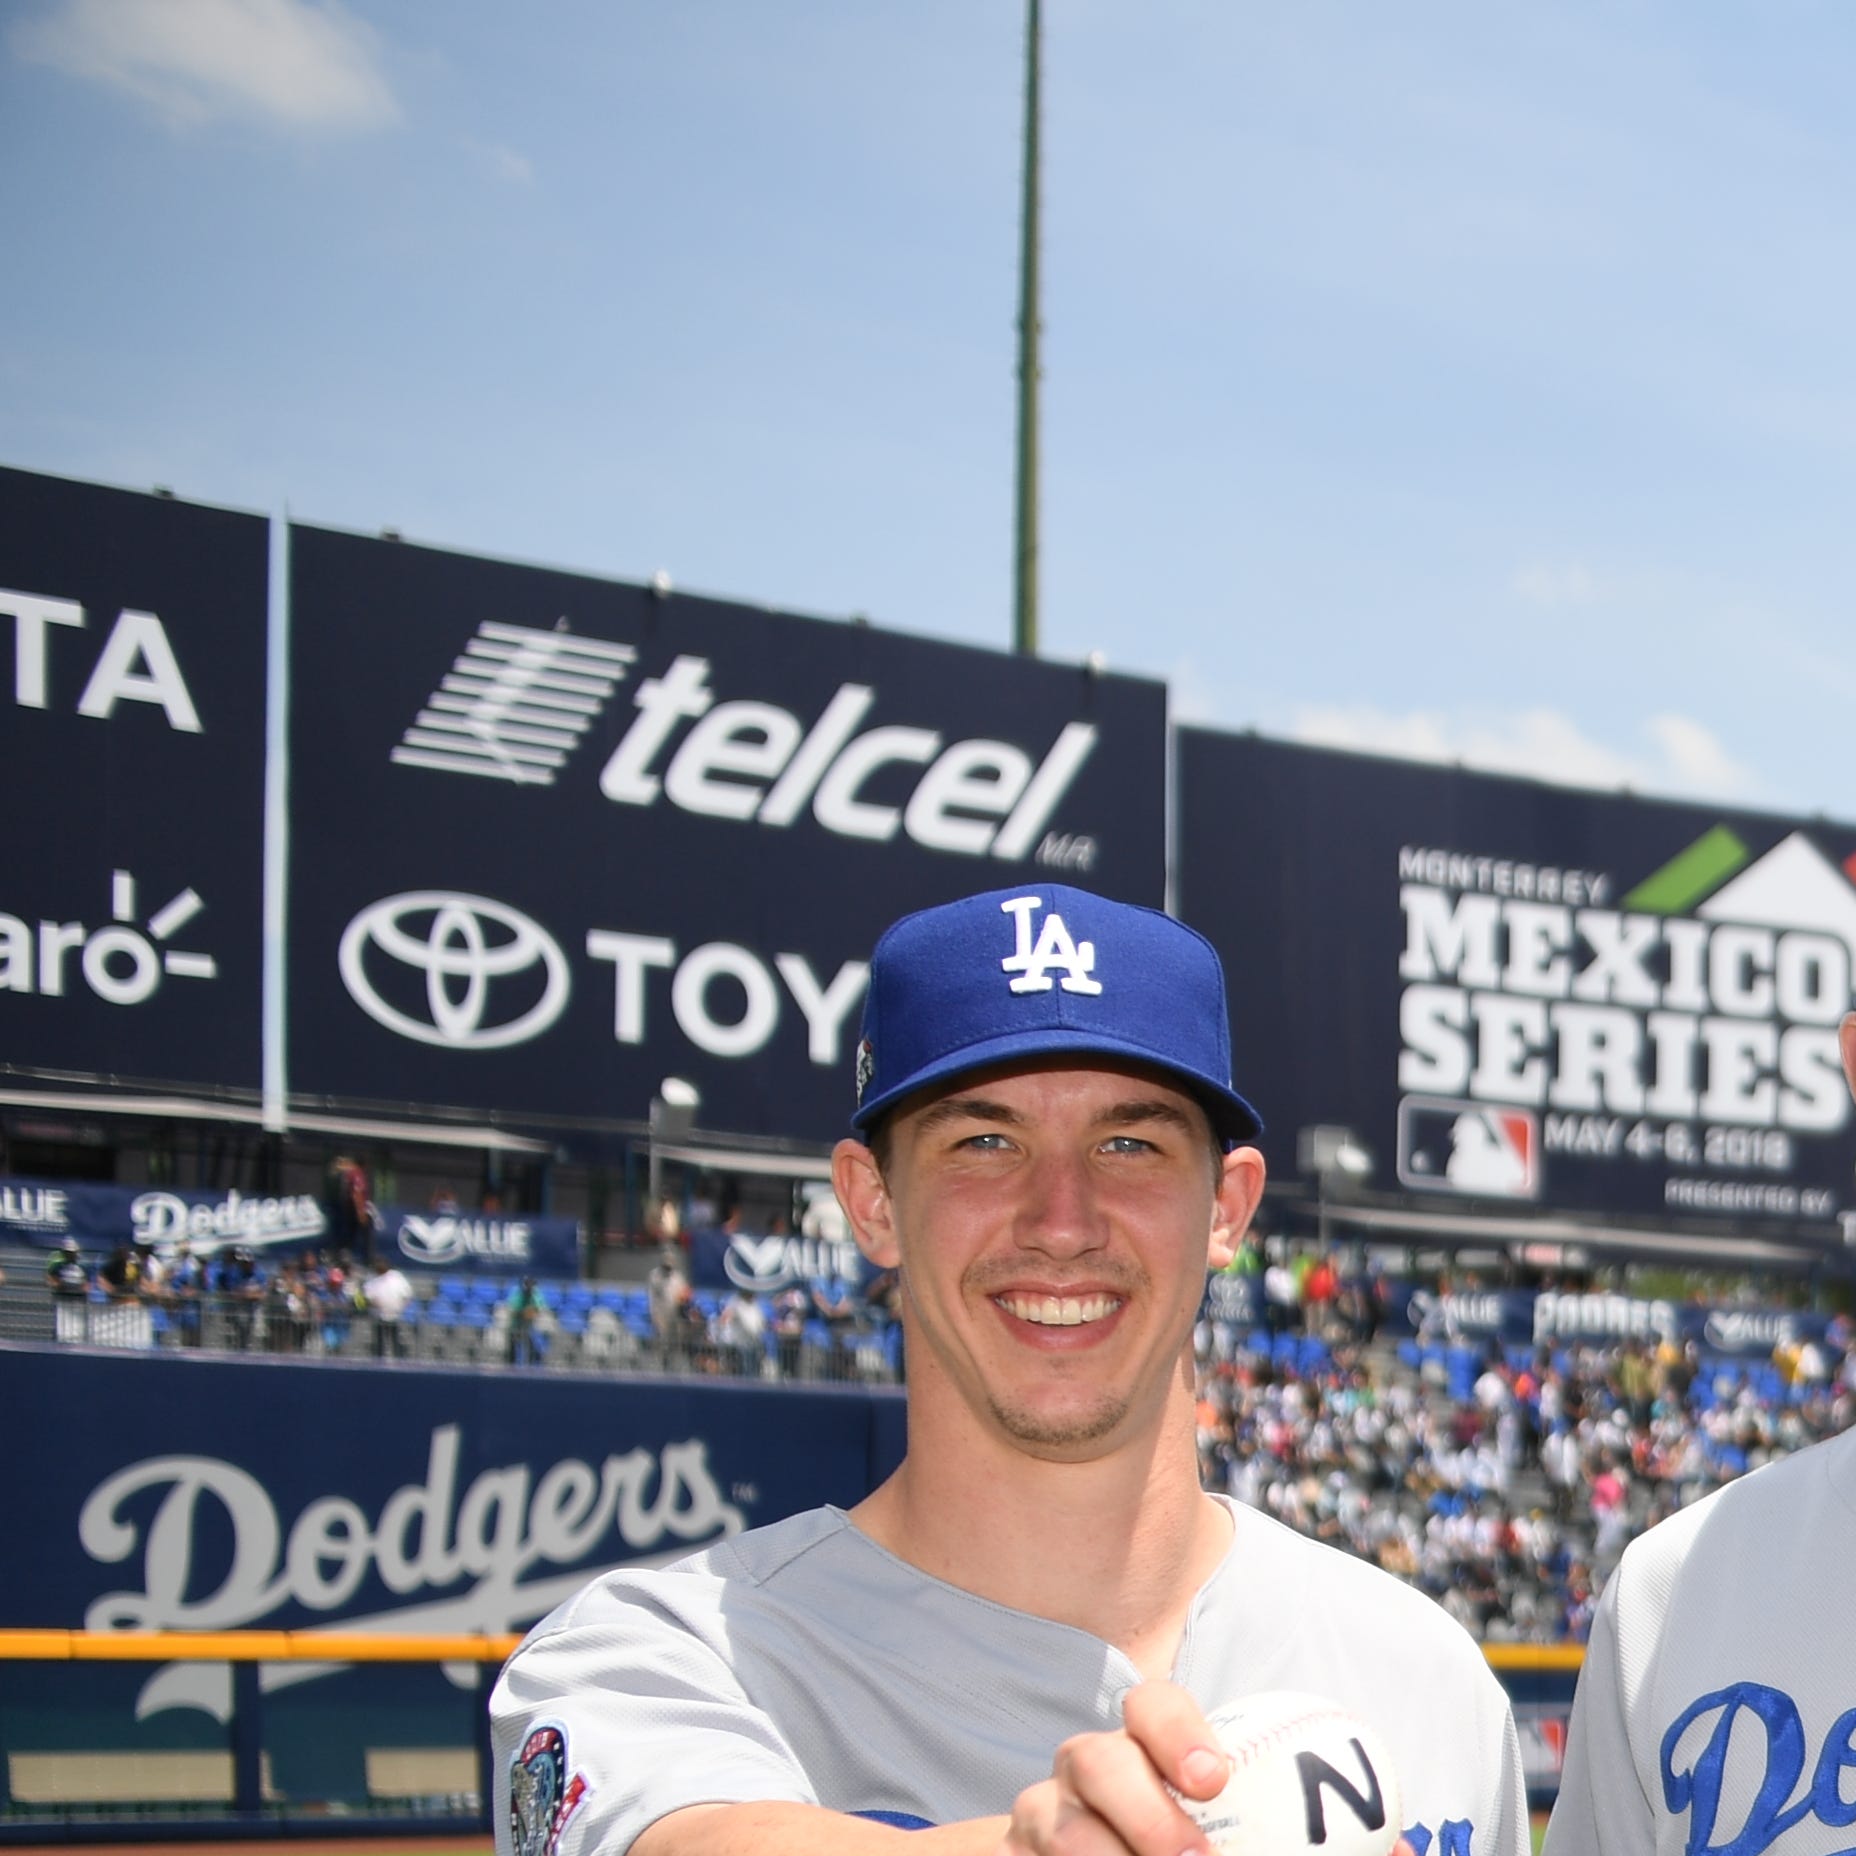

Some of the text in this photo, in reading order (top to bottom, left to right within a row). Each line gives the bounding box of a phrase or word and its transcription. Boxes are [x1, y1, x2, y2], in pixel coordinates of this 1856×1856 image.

[0, 590, 203, 733] TA
[600, 656, 1099, 862] telcel
[1400, 845, 1608, 905] MONTERREY
[587, 930, 872, 1065] TOY
[1002, 897, 1102, 996] LA
[1400, 884, 1849, 1025] MEXICO
[1399, 982, 1849, 1134] SERIES
[1544, 1113, 1618, 1154] MAY
[1705, 1127, 1791, 1169] 2018
[1665, 1178, 1833, 1215] PRESENTED BY
[131, 1188, 326, 1252] Dodgers
[79, 1423, 746, 1690] Dodgers
[1295, 1737, 1386, 1846] N
